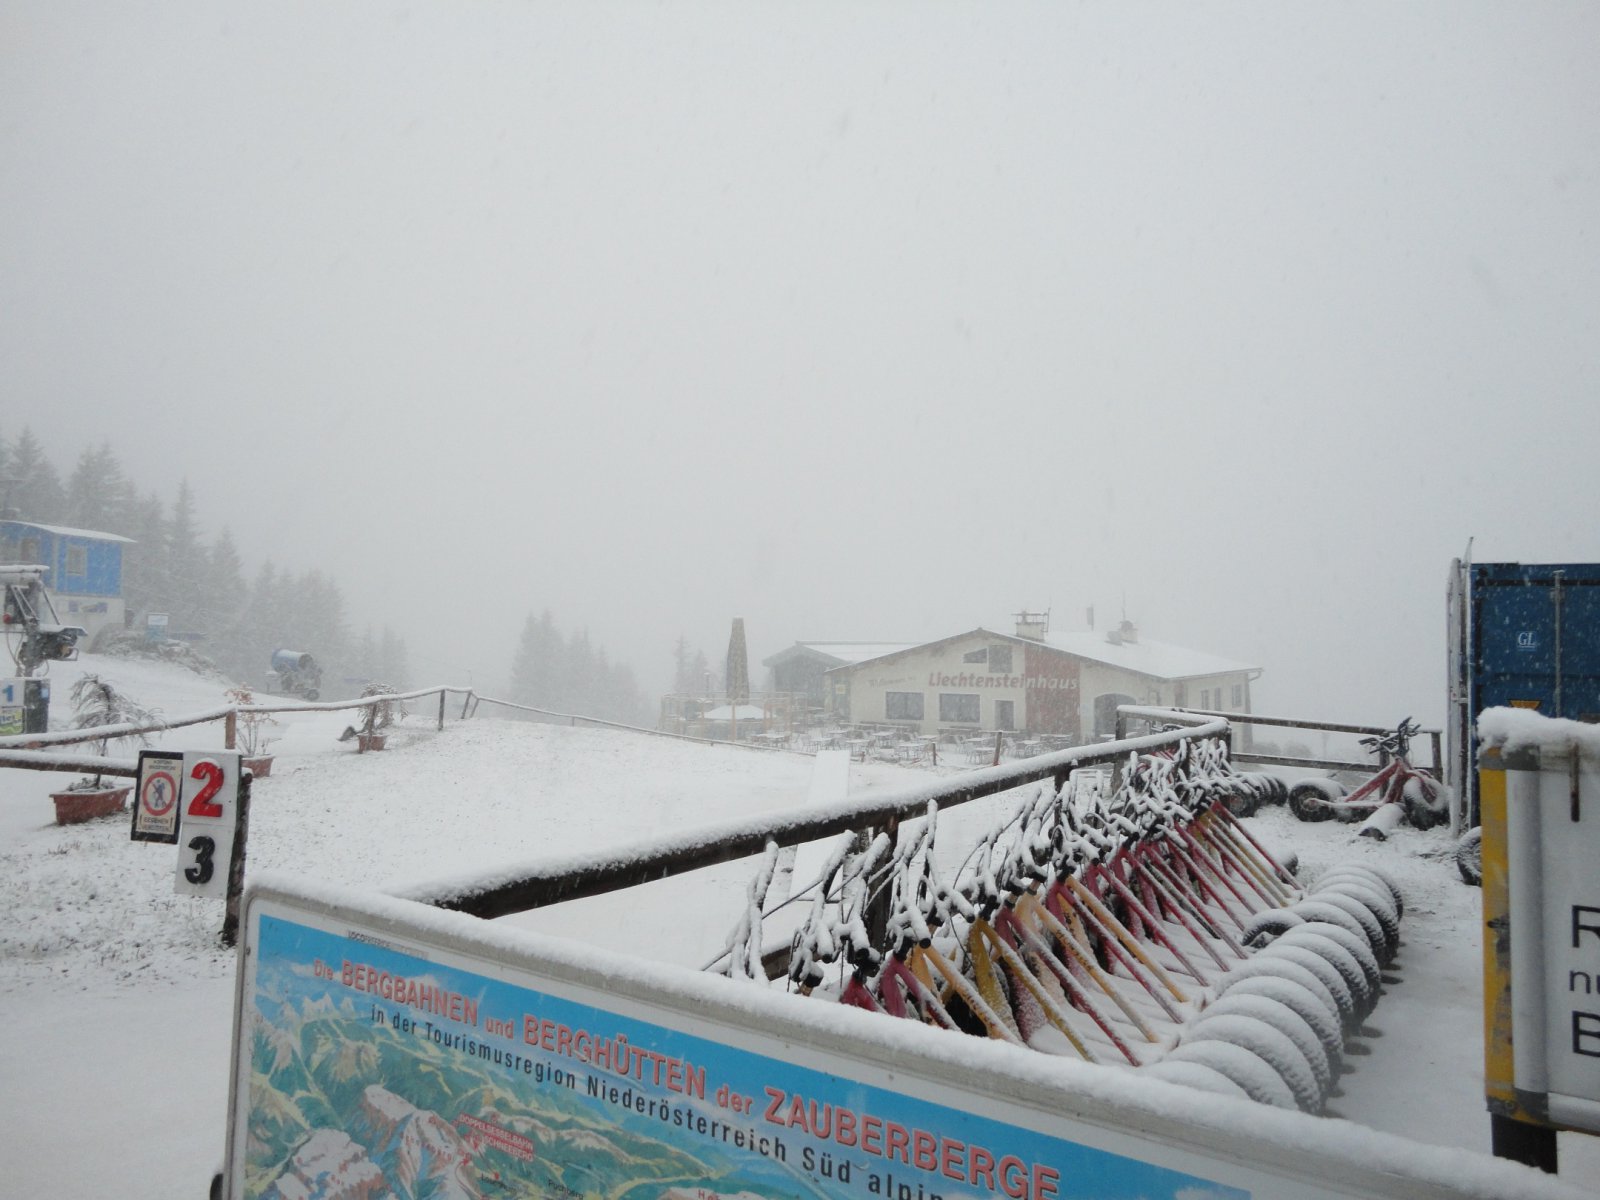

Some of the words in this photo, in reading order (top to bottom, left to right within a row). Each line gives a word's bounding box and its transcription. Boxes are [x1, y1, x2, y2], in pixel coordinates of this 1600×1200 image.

[2, 685, 14, 702] 1
[928, 671, 1079, 690] Liechtensteinhaus
[187, 760, 224, 817] 2
[184, 835, 216, 884] 3
[314, 958, 334, 981] Die
[341, 960, 479, 1027] BERGBAHNEN
[485, 1017, 514, 1040] und
[523, 1013, 707, 1101] BERGHÜTTEN
[716, 1083, 753, 1116] der
[764, 1086, 1061, 1200] ZAUBERBERGE
[371, 1003, 385, 1024] in
[392, 1013, 417, 1035] der
[424, 1021, 578, 1091] Tourismusregion
[587, 1075, 786, 1162] Niederösterreich
[801, 1146, 851, 1184] Süd
[484, 1135, 533, 1162] SCHNEEBERG
